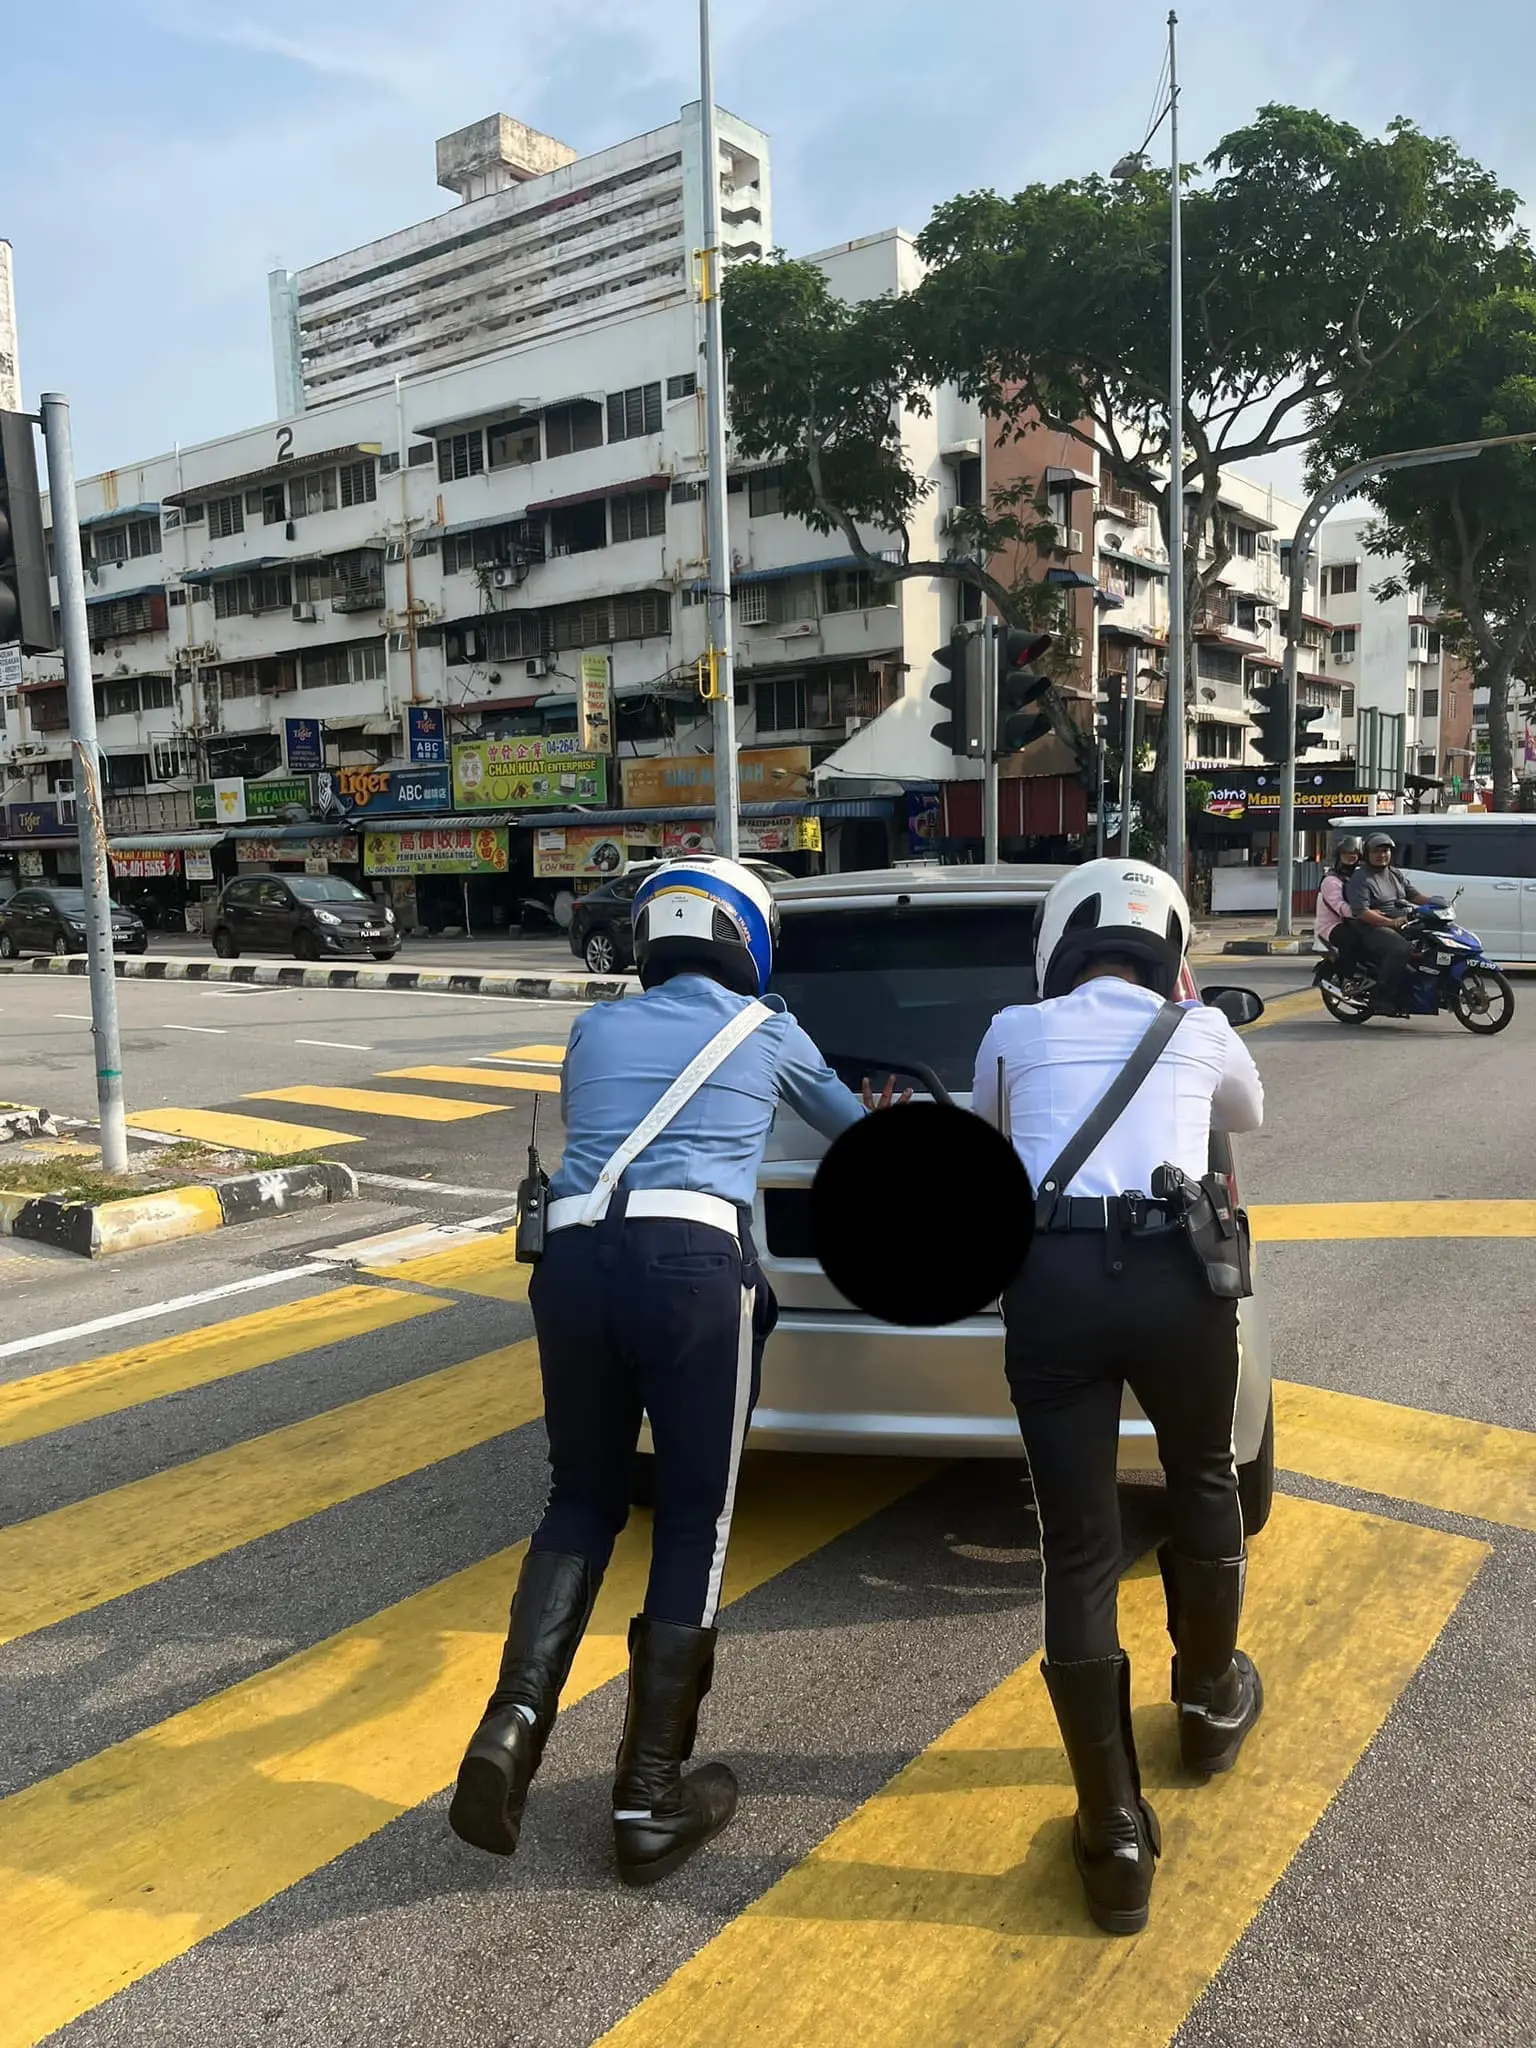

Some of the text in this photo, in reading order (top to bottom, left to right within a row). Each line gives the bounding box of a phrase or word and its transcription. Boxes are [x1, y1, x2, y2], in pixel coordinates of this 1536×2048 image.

[276, 426, 294, 463] 2
[416, 720, 437, 733] Tiger
[416, 742, 439, 752] ABC
[488, 760, 597, 776] CHAN HUAT ENTERPRISE
[336, 765, 391, 807] Tiger
[398, 784, 422, 801] ABC
[248, 788, 307, 805] MACALLUM
[1248, 793, 1280, 805] Mam
[1294, 792, 1369, 808] Georgetown
[19, 812, 40, 832] Tiger
[1122, 872, 1154, 885] GIVI
[675, 908, 684, 920] 4
